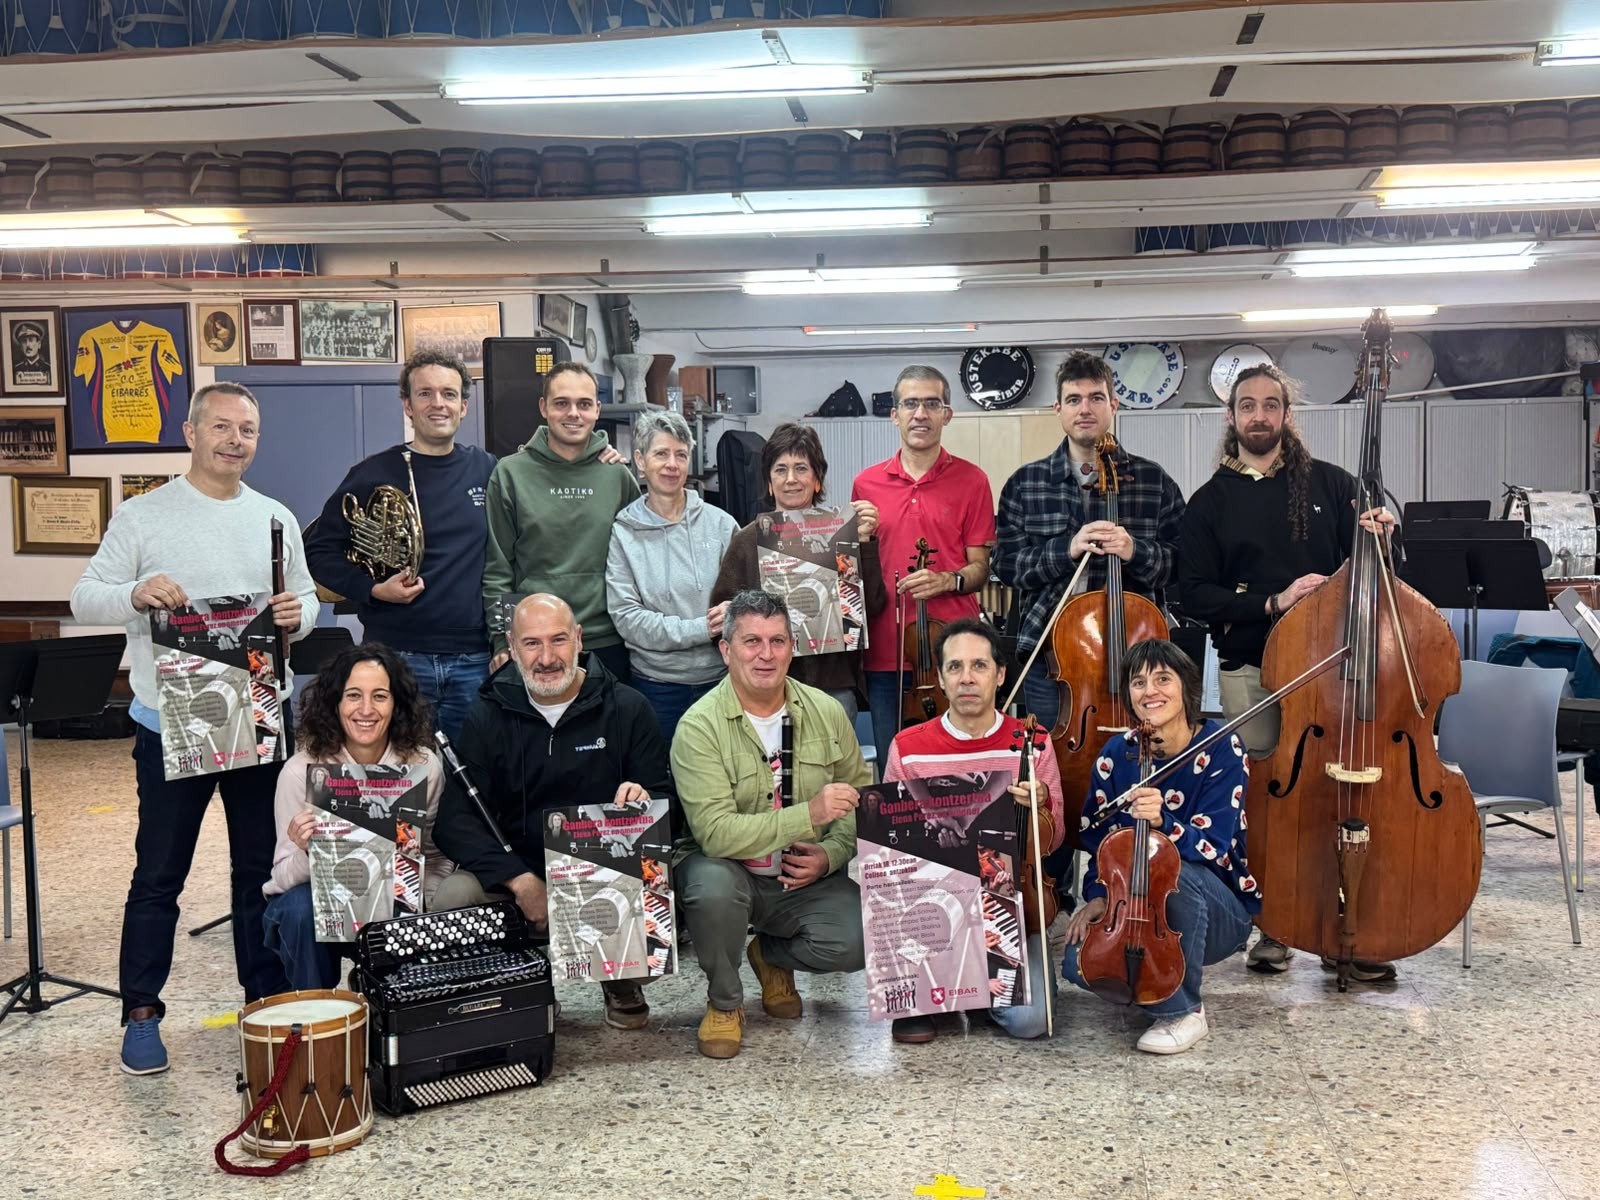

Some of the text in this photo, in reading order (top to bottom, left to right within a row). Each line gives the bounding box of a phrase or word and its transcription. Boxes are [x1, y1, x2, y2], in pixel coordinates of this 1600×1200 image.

[969, 346, 1020, 392] USTEKABE
[994, 379, 1024, 400] EIBAR
[880, 793, 991, 815] Ganbera kontzertua
[563, 819, 602, 830] Ganbera
[949, 987, 978, 996] EIBAR
